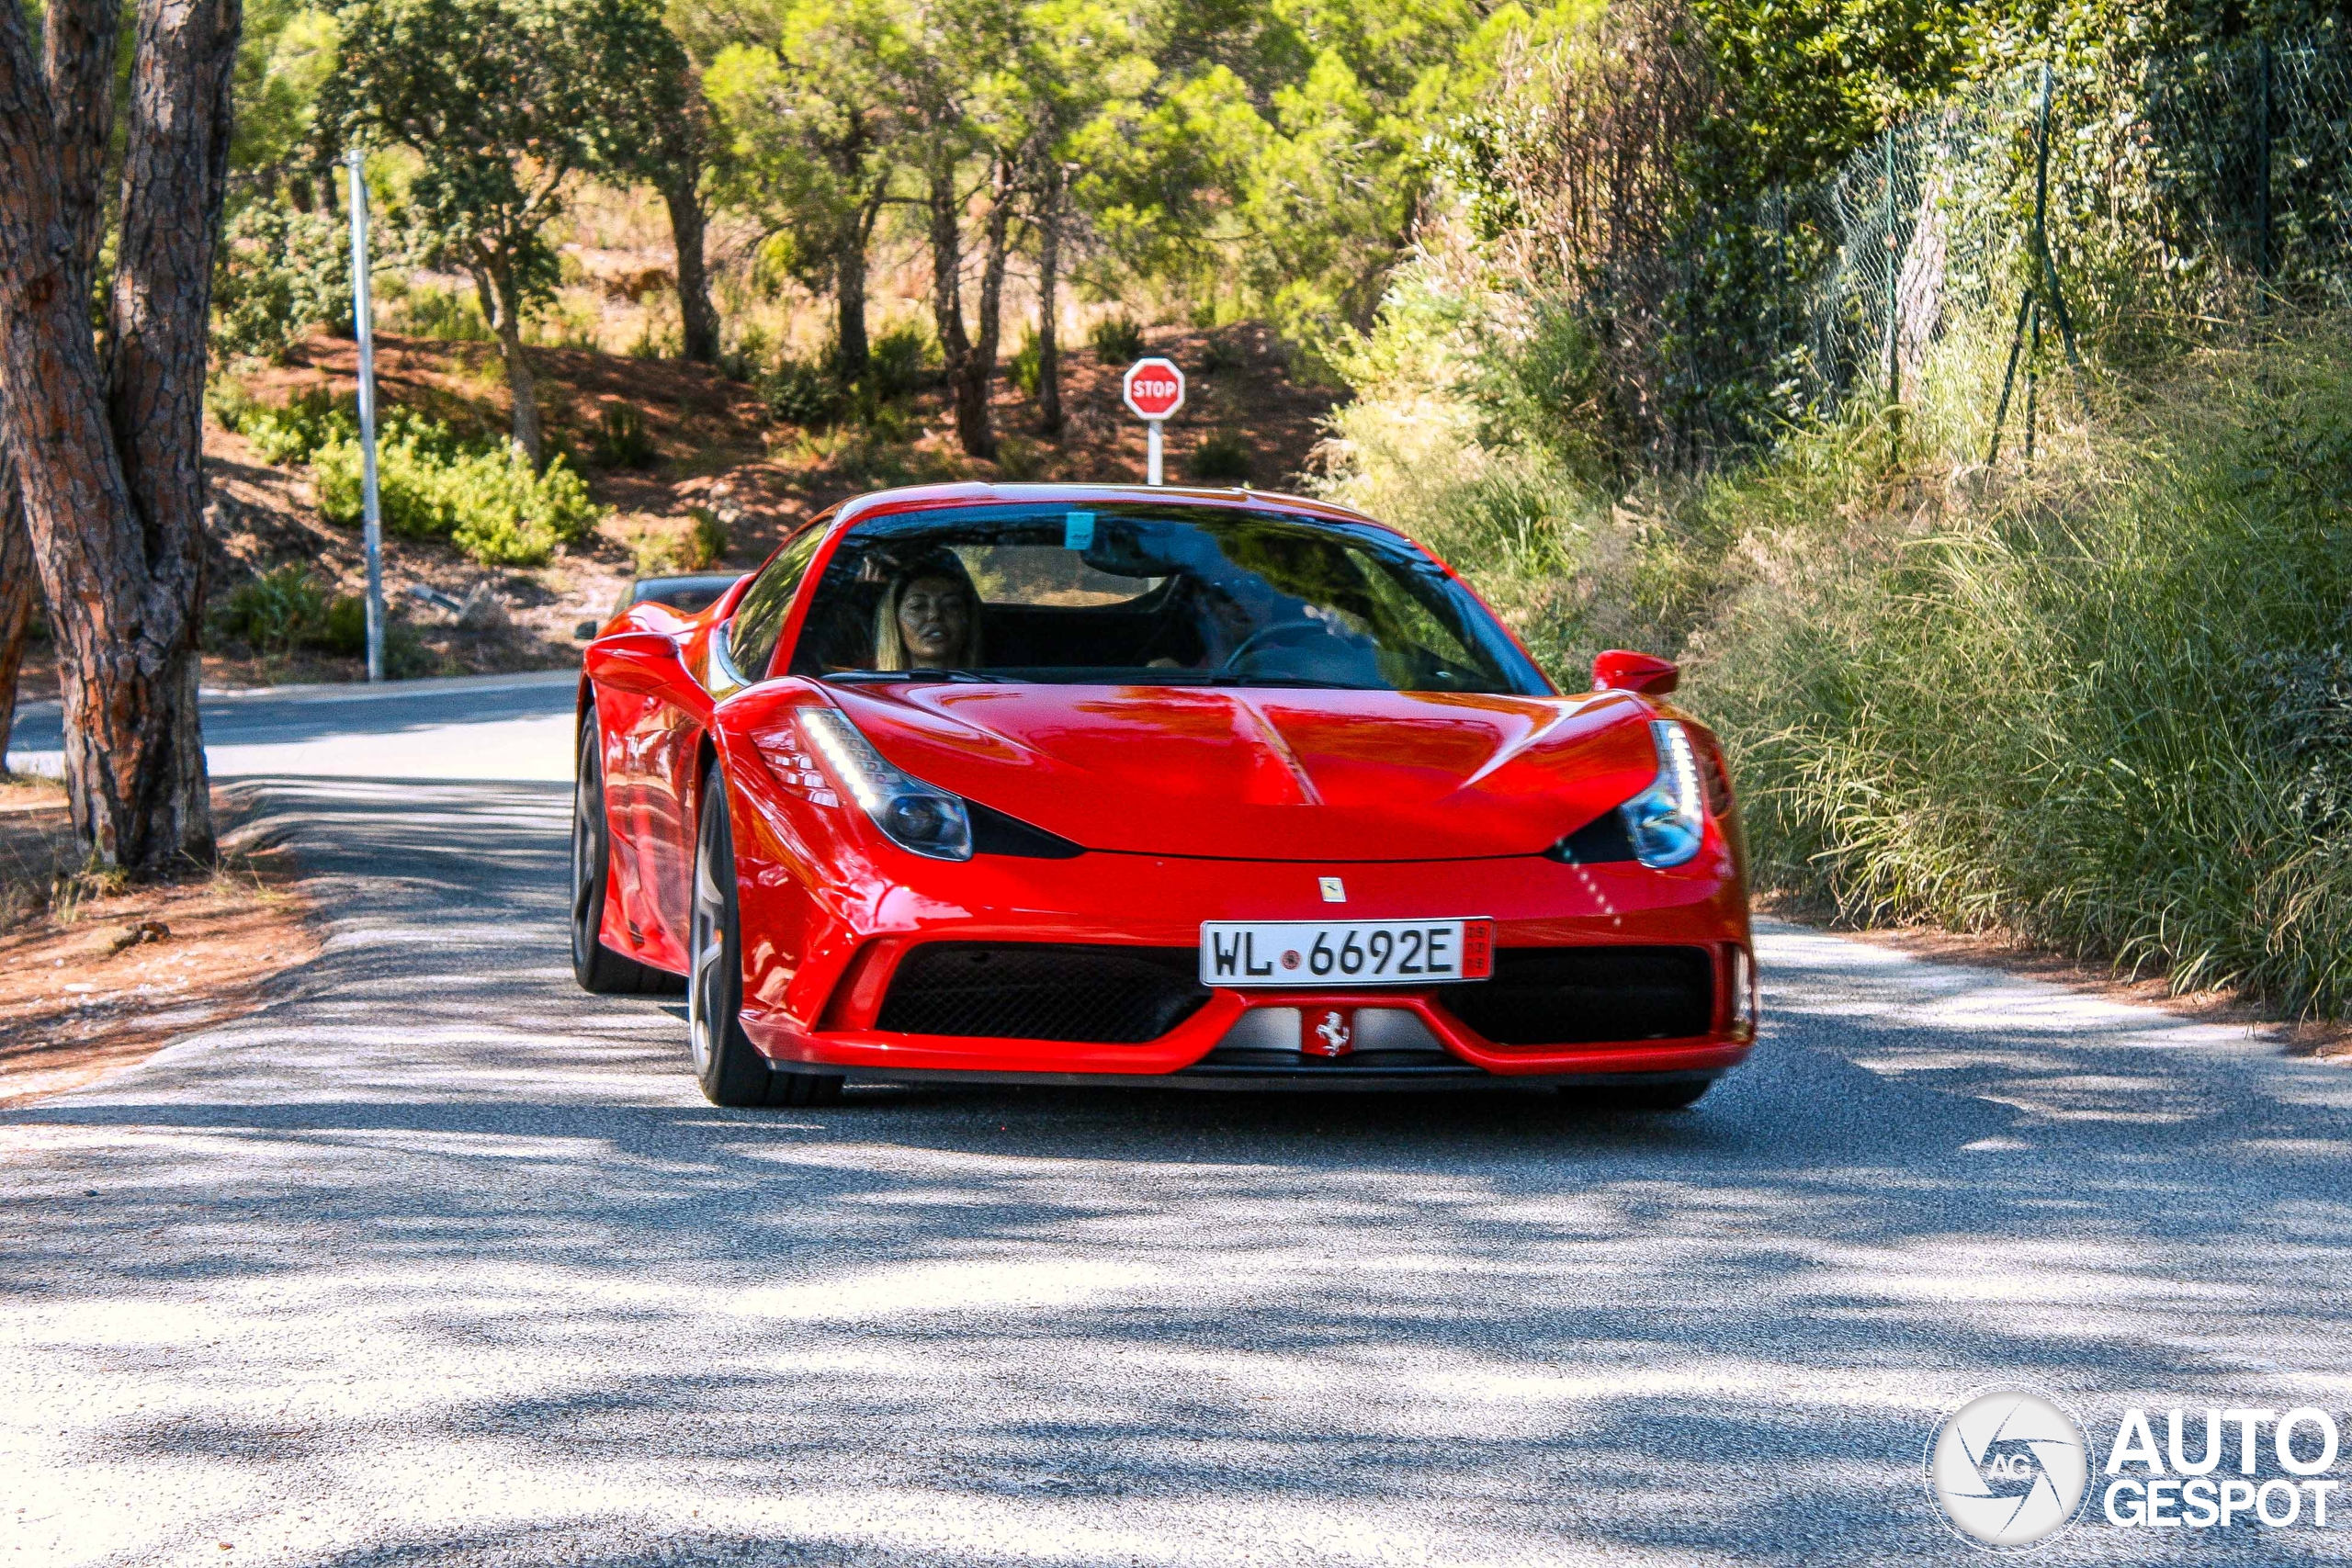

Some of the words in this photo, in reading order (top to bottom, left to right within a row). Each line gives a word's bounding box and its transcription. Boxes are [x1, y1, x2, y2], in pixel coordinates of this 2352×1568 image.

[1133, 380, 1177, 398] STOP
[1213, 931, 1273, 976] WL
[1309, 928, 1453, 976] 6692E
